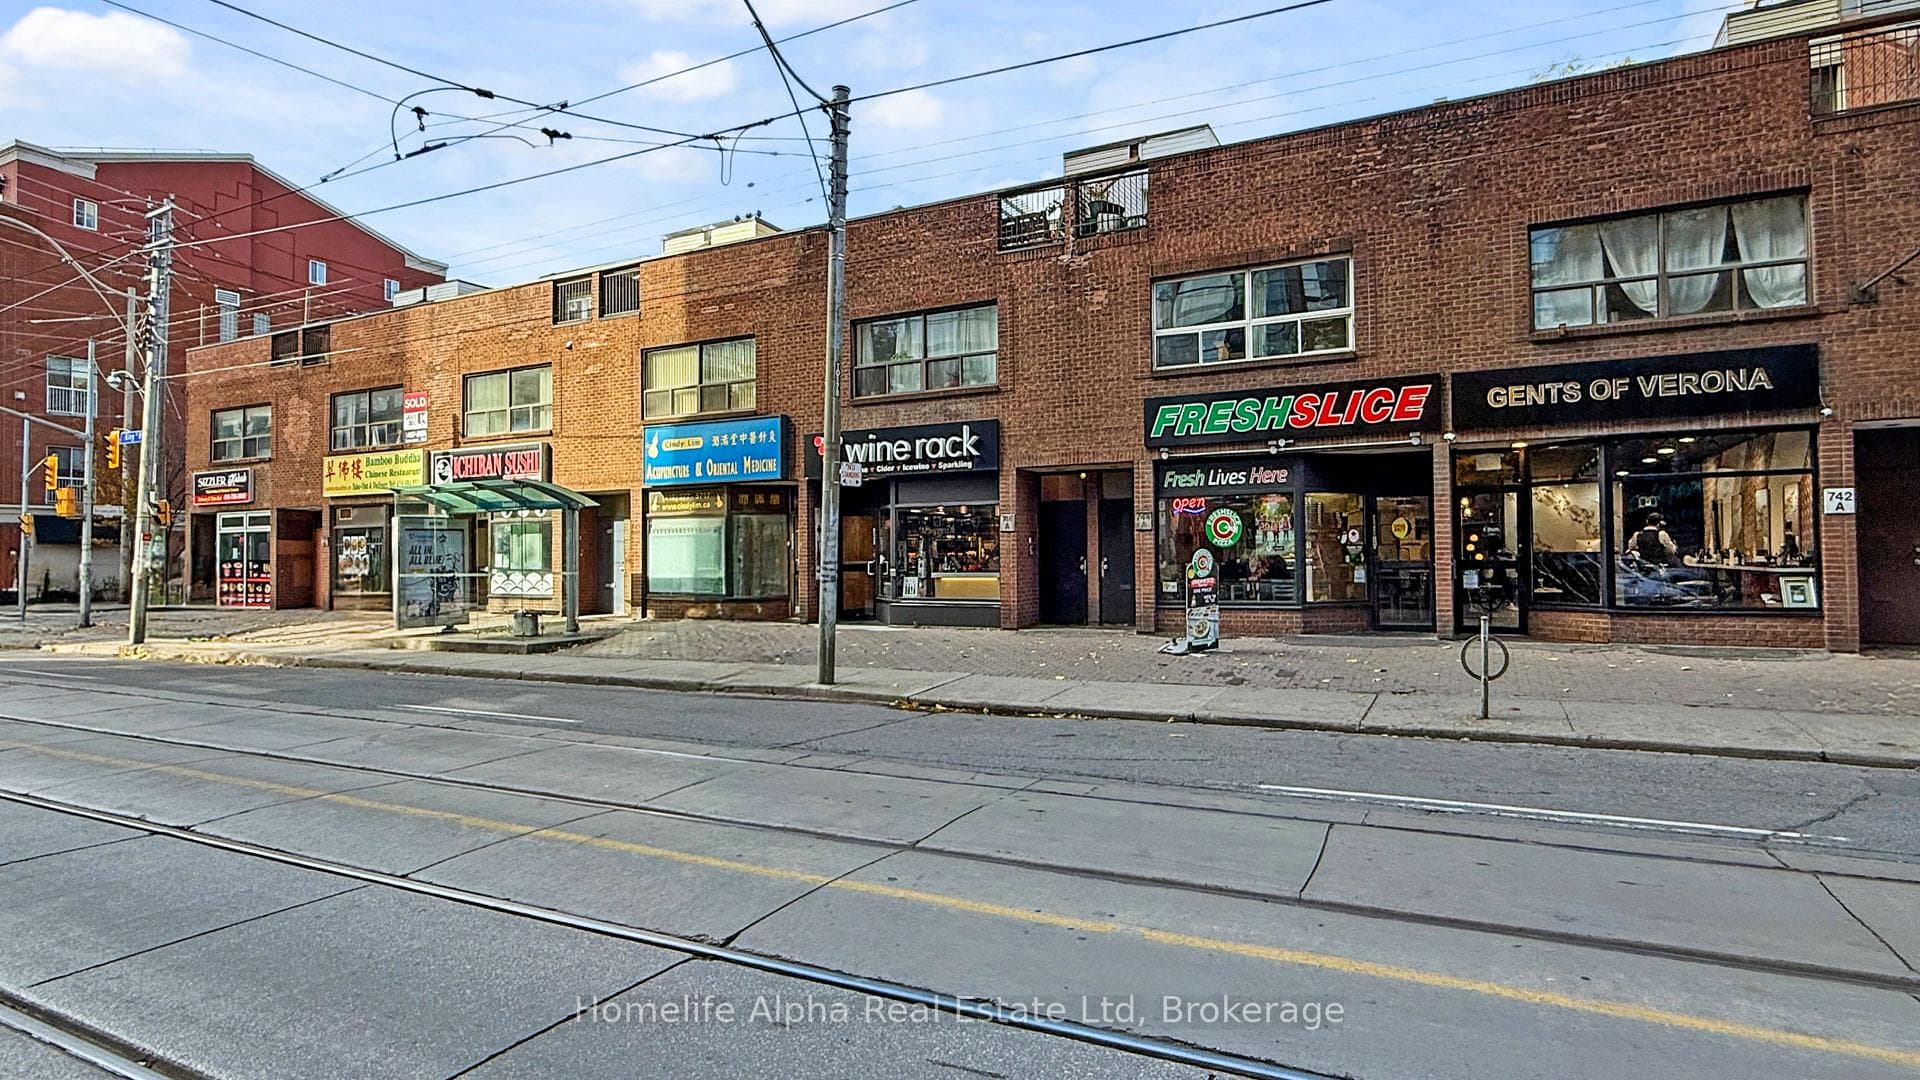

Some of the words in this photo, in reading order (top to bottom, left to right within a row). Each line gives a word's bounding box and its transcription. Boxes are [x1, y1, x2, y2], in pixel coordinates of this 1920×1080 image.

[1486, 381, 1582, 408] GENTS
[1589, 377, 1629, 400] OF
[1637, 367, 1774, 397] VERONA
[404, 396, 426, 409] SOLD
[1150, 384, 1432, 438] FRESHSLICE
[845, 434, 911, 463] wine
[915, 425, 981, 460] rack
[365, 455, 393, 467] Bamboo
[395, 453, 421, 464] Buddha
[453, 453, 502, 479] ICHIBAN
[504, 450, 539, 475] SUSHI
[876, 464, 895, 473] Cider
[902, 463, 930, 471] Icewine
[938, 460, 973, 470] Sparkling
[364, 470, 388, 478] Chinese
[1164, 469, 1206, 488] Fresh
[1208, 469, 1247, 486] Lives
[1249, 466, 1288, 484] Here
[198, 475, 226, 487] SIZZLER
[1827, 491, 1853, 502] 742
[1835, 502, 1845, 511] A
[1213, 537, 1235, 548] PIZZA
